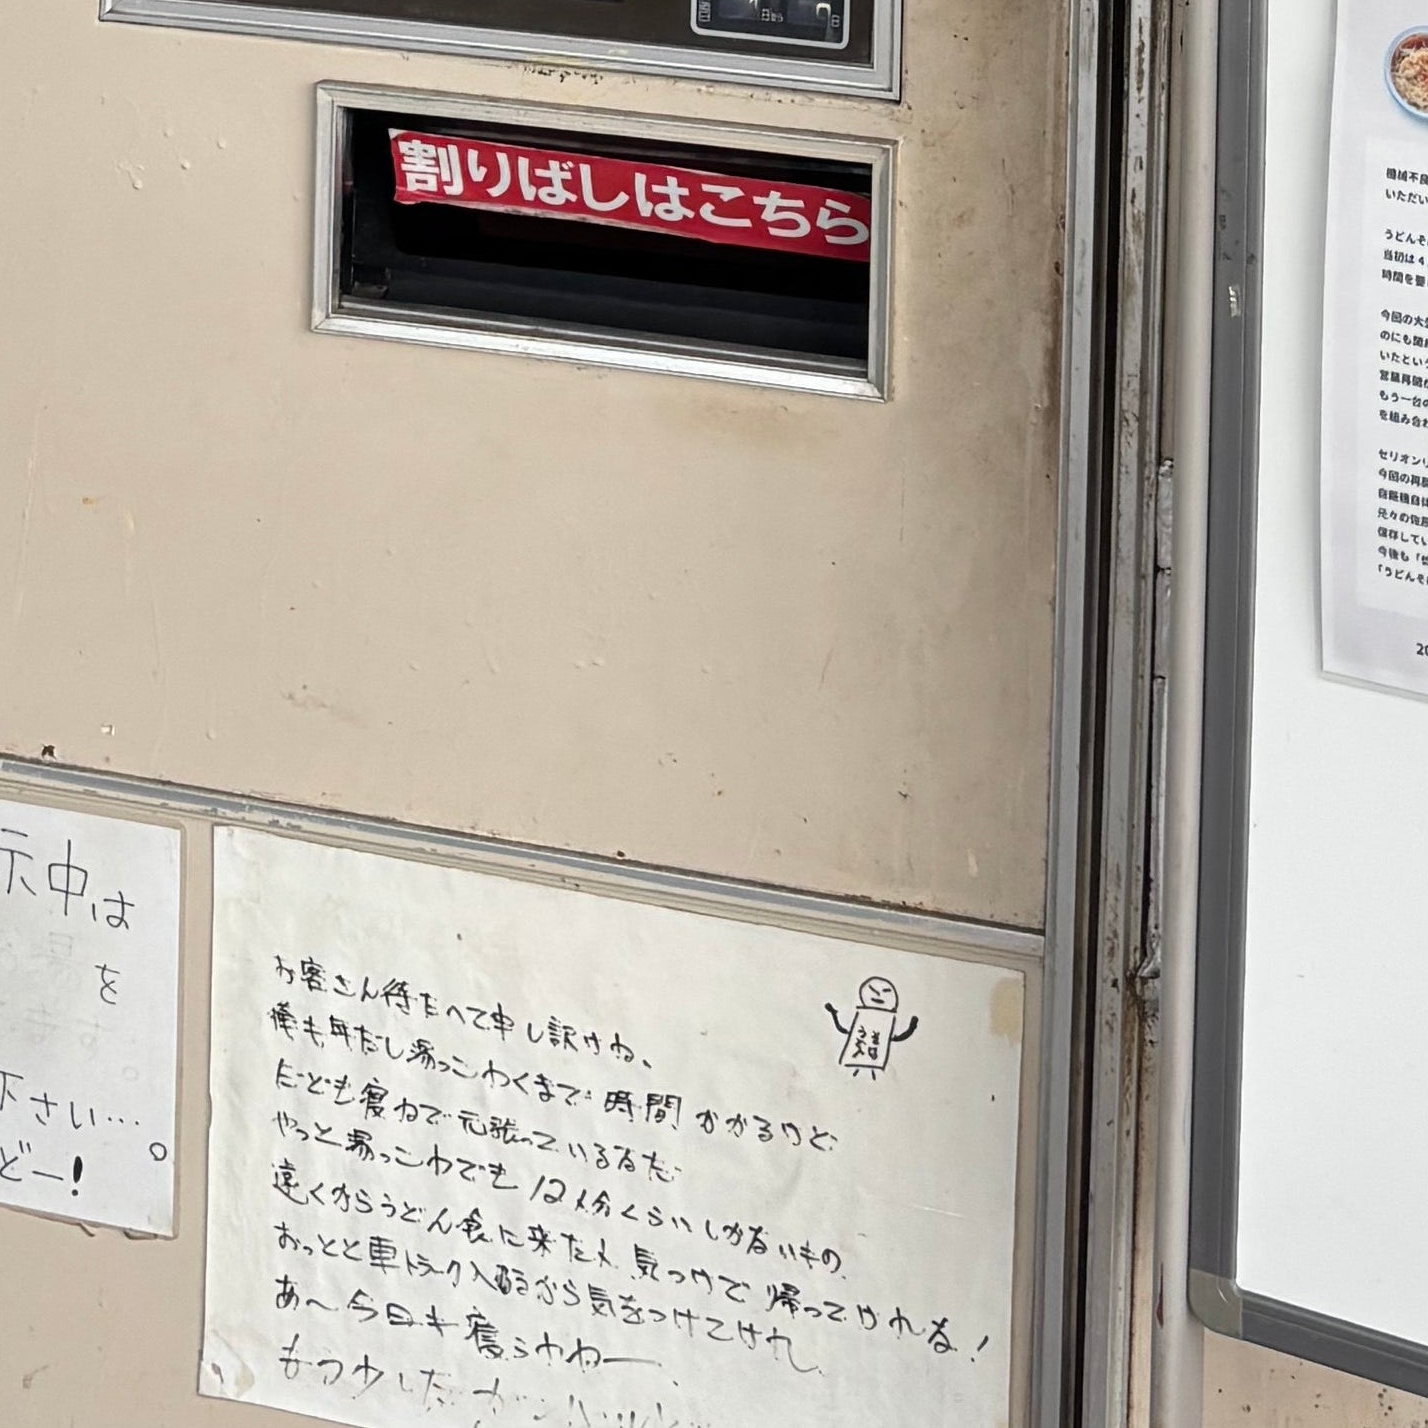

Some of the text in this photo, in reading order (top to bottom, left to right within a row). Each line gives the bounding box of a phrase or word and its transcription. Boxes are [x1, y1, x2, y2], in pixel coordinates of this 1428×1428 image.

[400, 138, 869, 247] 割りばしはこちら
